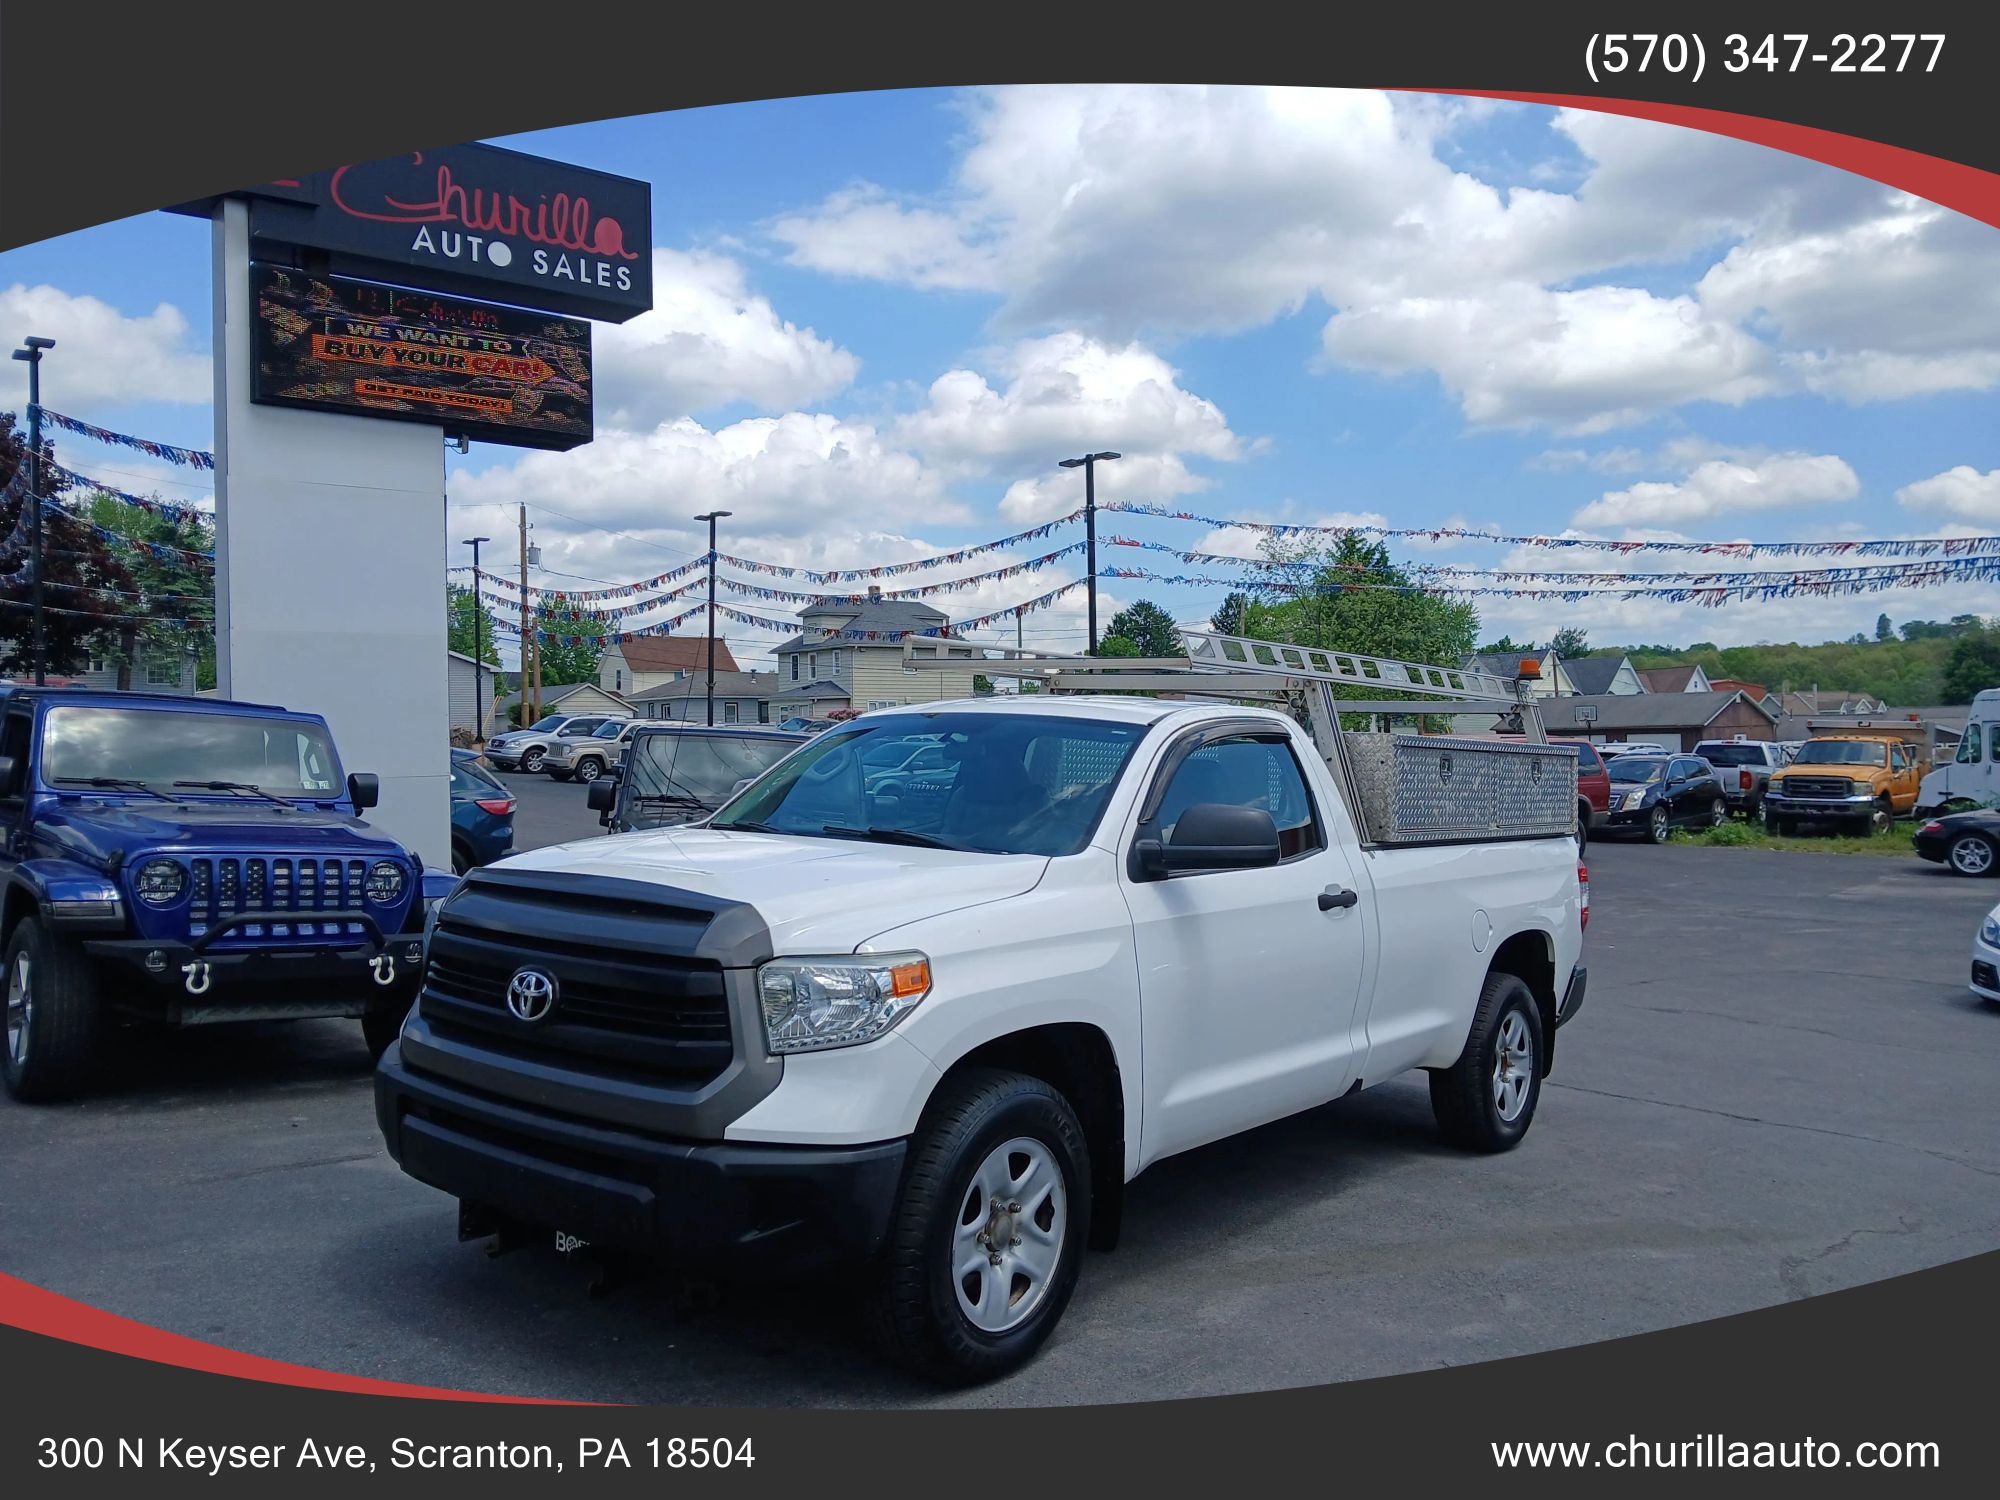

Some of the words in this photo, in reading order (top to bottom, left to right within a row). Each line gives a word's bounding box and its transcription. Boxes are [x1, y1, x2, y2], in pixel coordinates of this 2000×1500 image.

[331, 152, 638, 260] Churilla
[411, 225, 512, 267] AUTO
[533, 249, 632, 291] SALES
[324, 340, 388, 361] BUY
[393, 346, 467, 369] YOUR
[471, 357, 545, 379] CAR!
[346, 323, 391, 339] WE
[396, 329, 473, 348] WANT
[477, 339, 512, 353] TO
